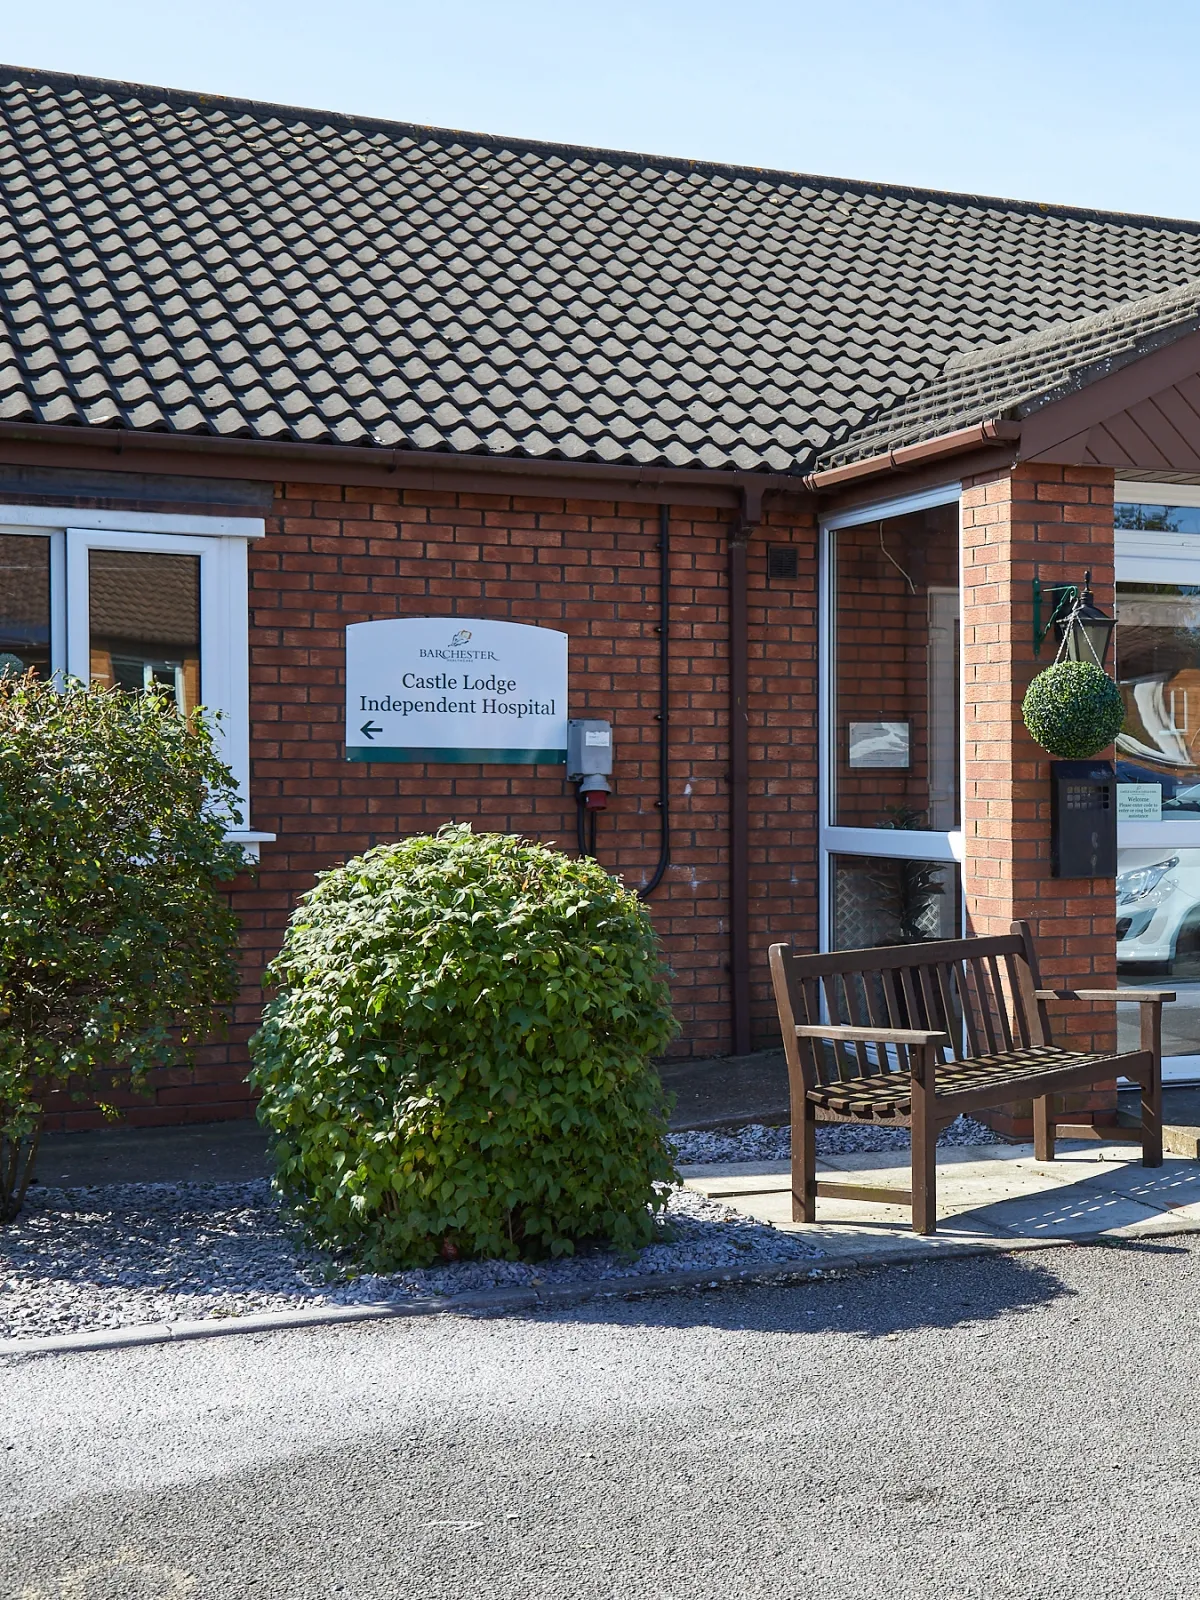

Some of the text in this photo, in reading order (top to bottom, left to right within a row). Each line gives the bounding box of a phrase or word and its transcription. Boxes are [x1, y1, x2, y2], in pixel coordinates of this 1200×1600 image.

[419, 649, 500, 661] BARCHESTER
[402, 673, 517, 695] Castle Lodge
[359, 695, 556, 718] Independent Hospital
